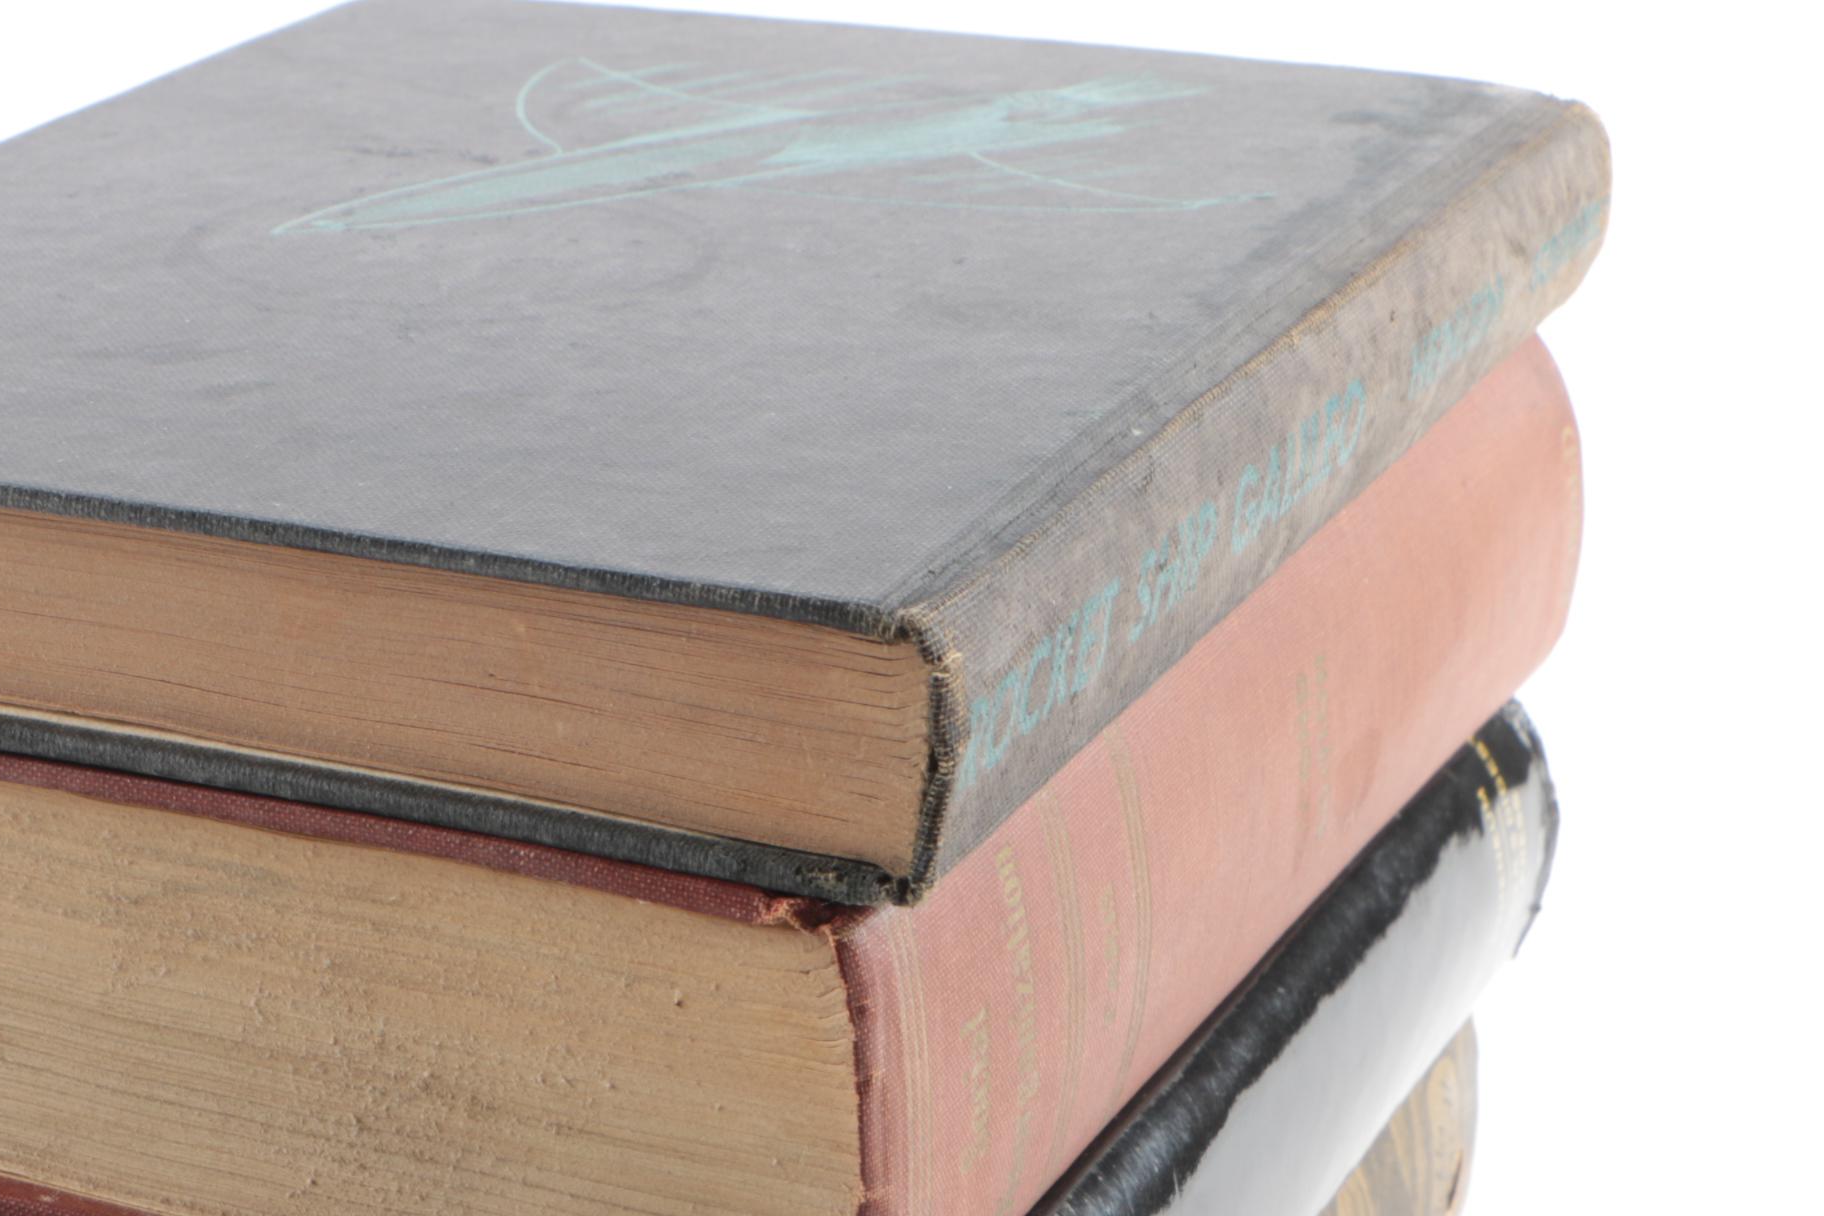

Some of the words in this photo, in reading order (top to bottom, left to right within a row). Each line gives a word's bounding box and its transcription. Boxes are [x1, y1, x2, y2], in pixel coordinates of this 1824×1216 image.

[954, 576, 1121, 796] ROCKET
[1128, 499, 1217, 642] SHIP
[1230, 379, 1366, 556] GALILEO
